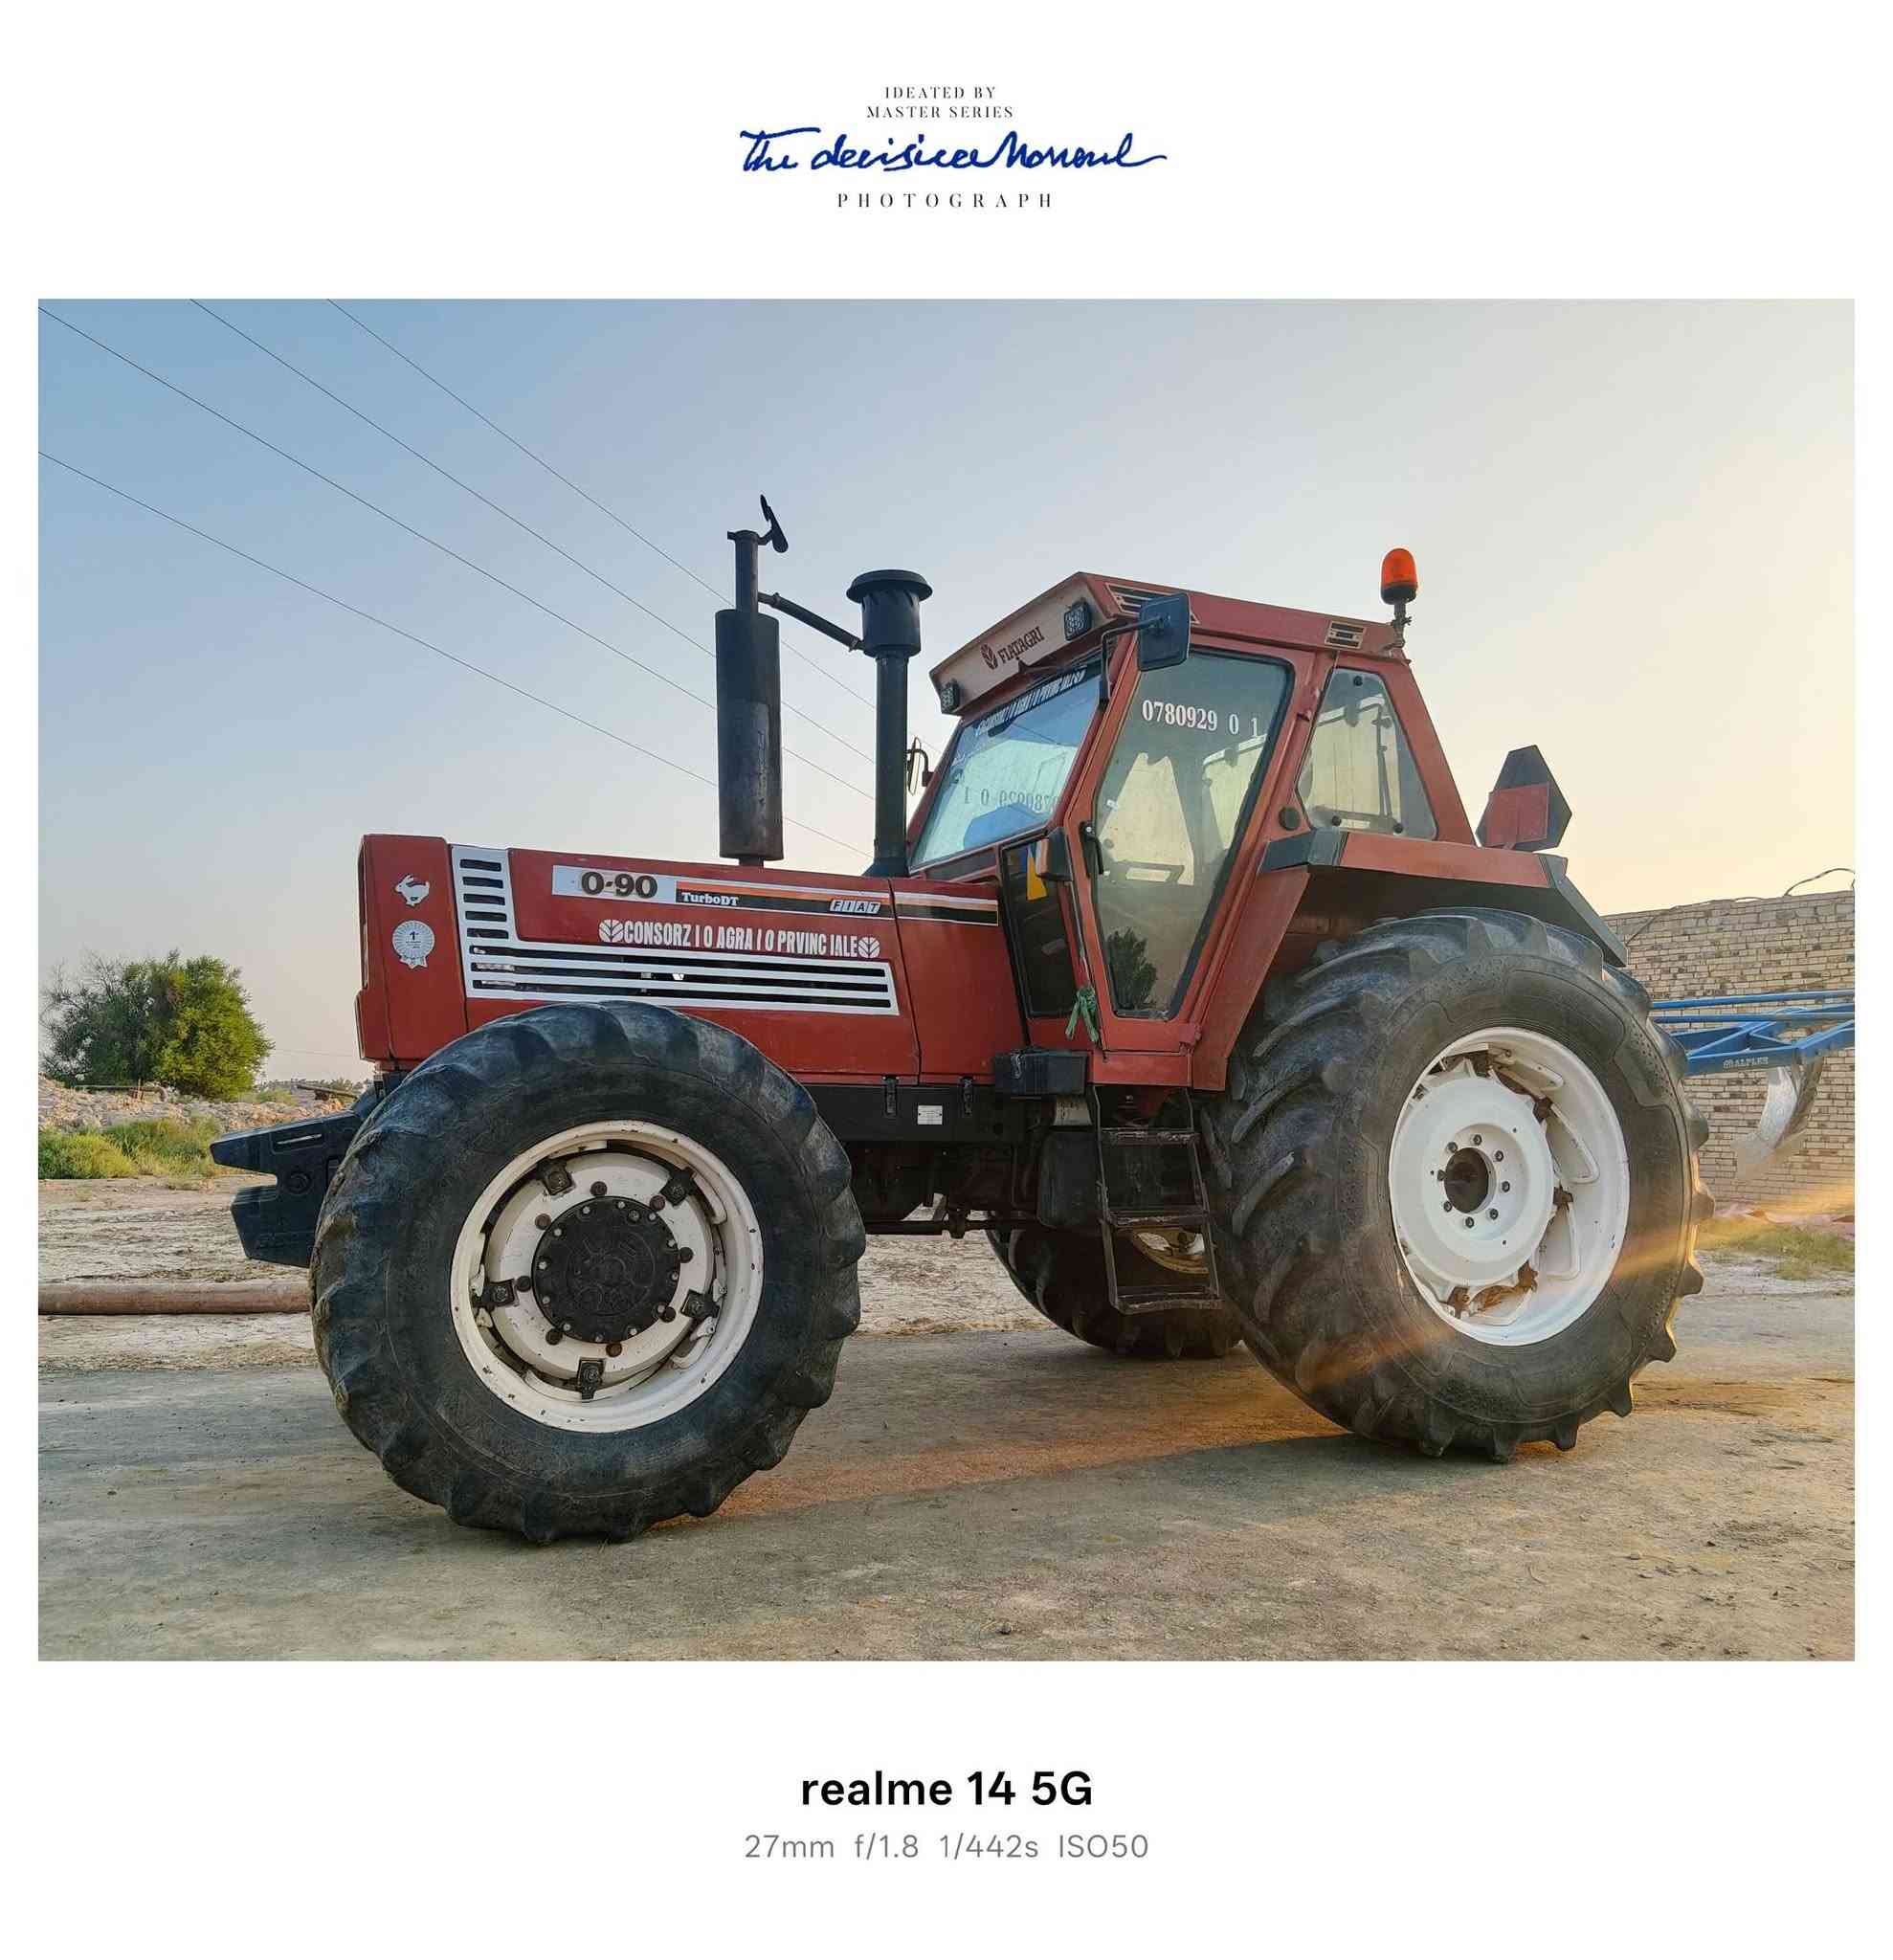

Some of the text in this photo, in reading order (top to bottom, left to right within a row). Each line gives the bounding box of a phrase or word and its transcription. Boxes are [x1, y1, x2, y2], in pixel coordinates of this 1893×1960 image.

[997, 626, 1045, 664] FIATAGRI
[1142, 699, 1258, 737] 0780929 0 1
[830, 900, 881, 913] FIAT
